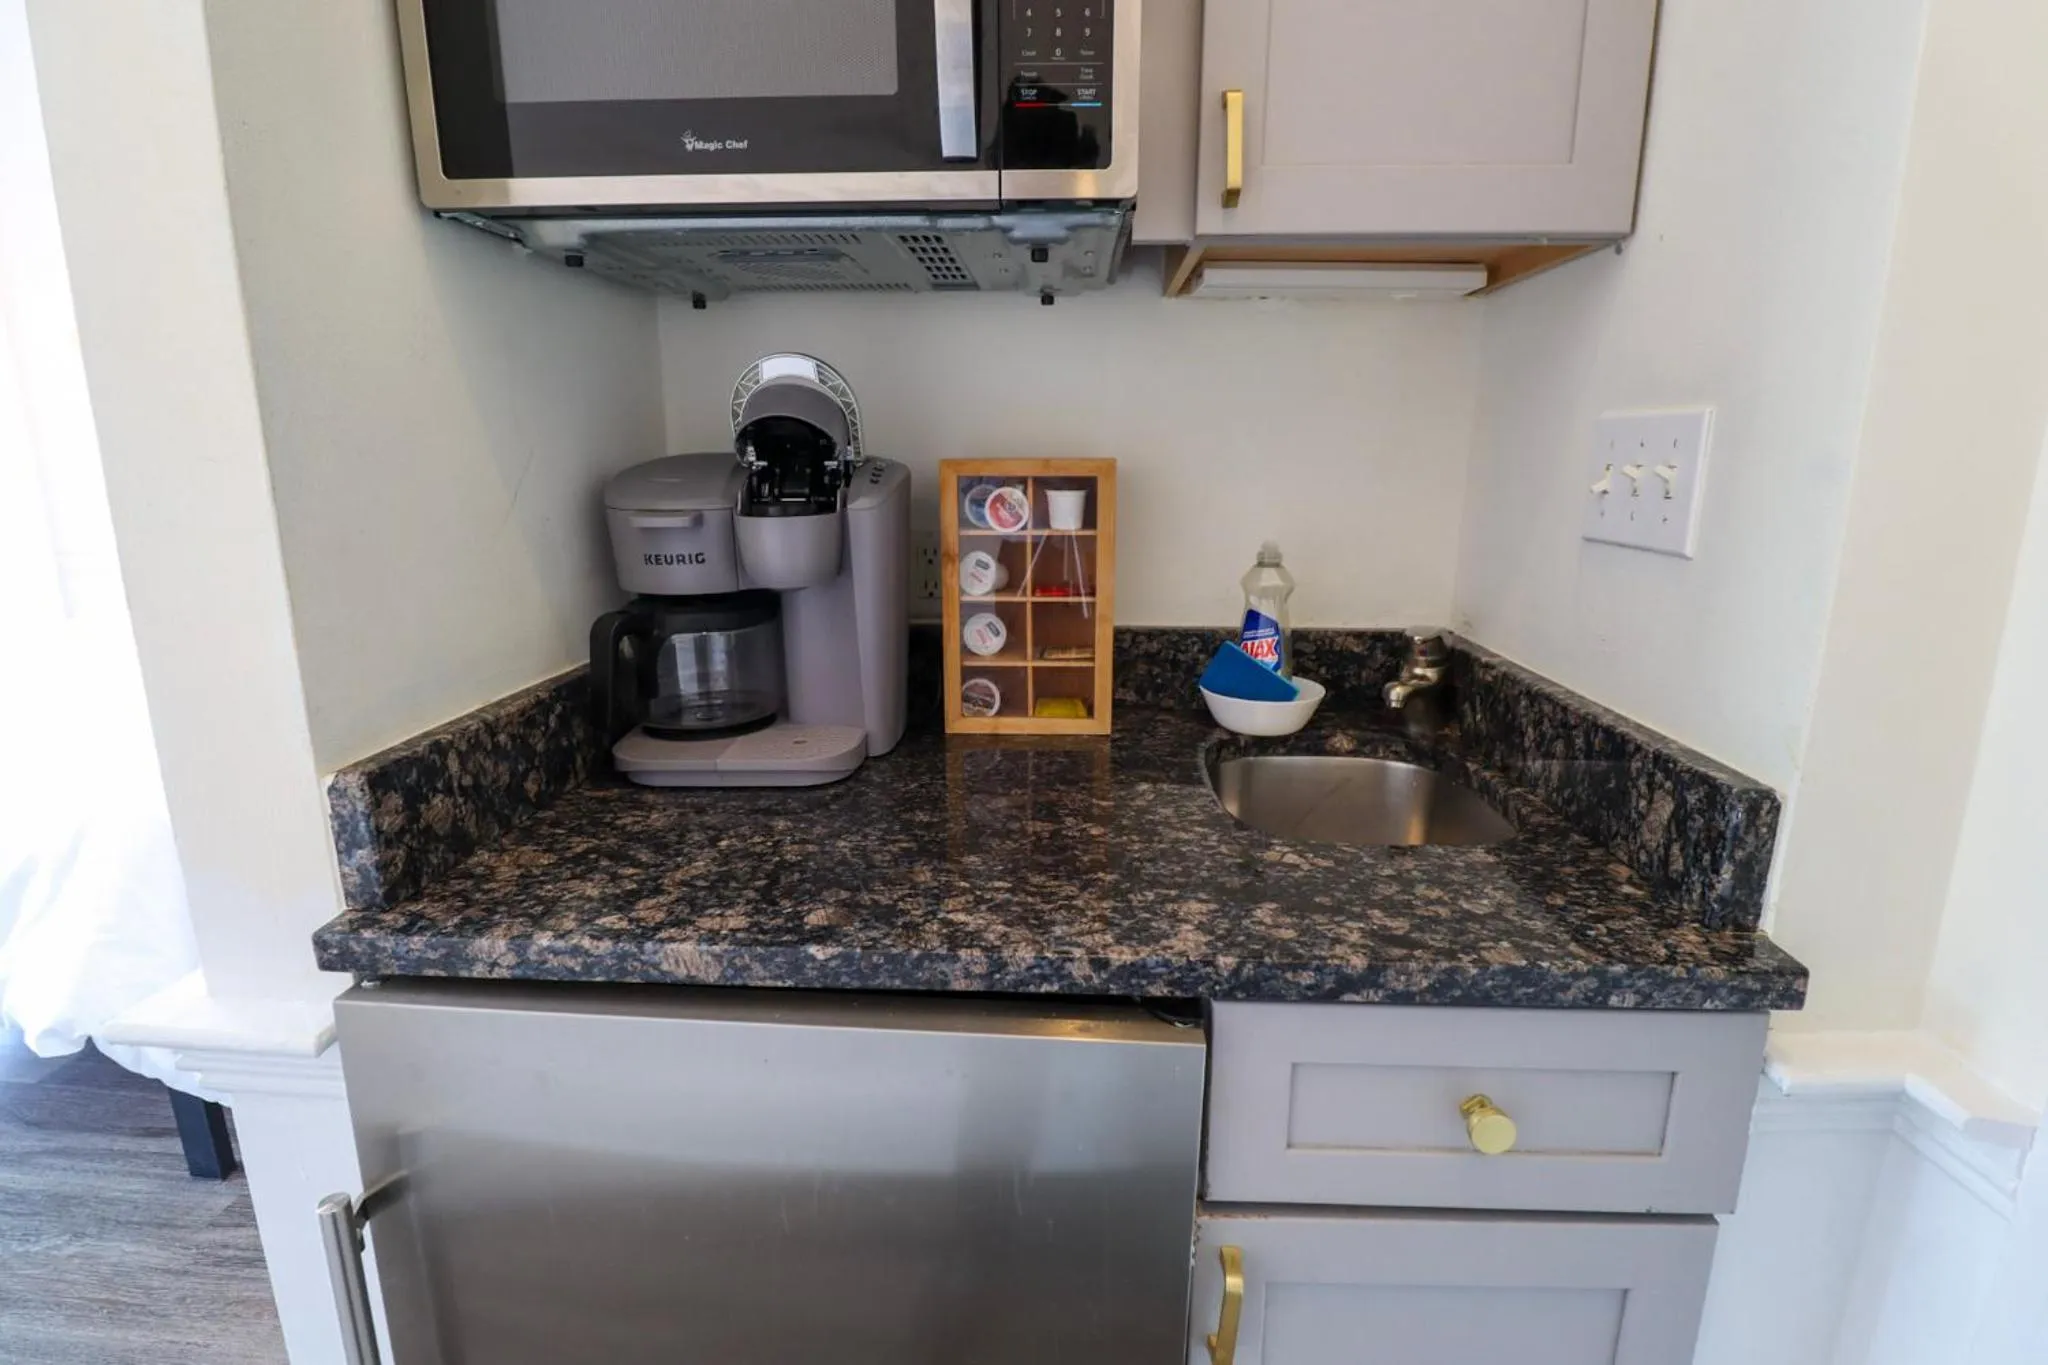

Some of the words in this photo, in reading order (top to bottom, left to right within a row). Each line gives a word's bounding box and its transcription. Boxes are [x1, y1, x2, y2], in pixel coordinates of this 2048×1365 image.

[1026, 8, 1032, 17] 4
[1055, 8, 1062, 17] 5
[1084, 8, 1091, 17] 6
[1055, 27, 1062, 37] 8
[1084, 27, 1091, 37] 9
[1055, 48, 1062, 56] 0
[1020, 88, 1038, 96] STOP
[1077, 88, 1097, 96] START
[694, 139, 723, 152] Magic
[725, 139, 748, 150] Chef
[643, 552, 706, 566] KEURIG
